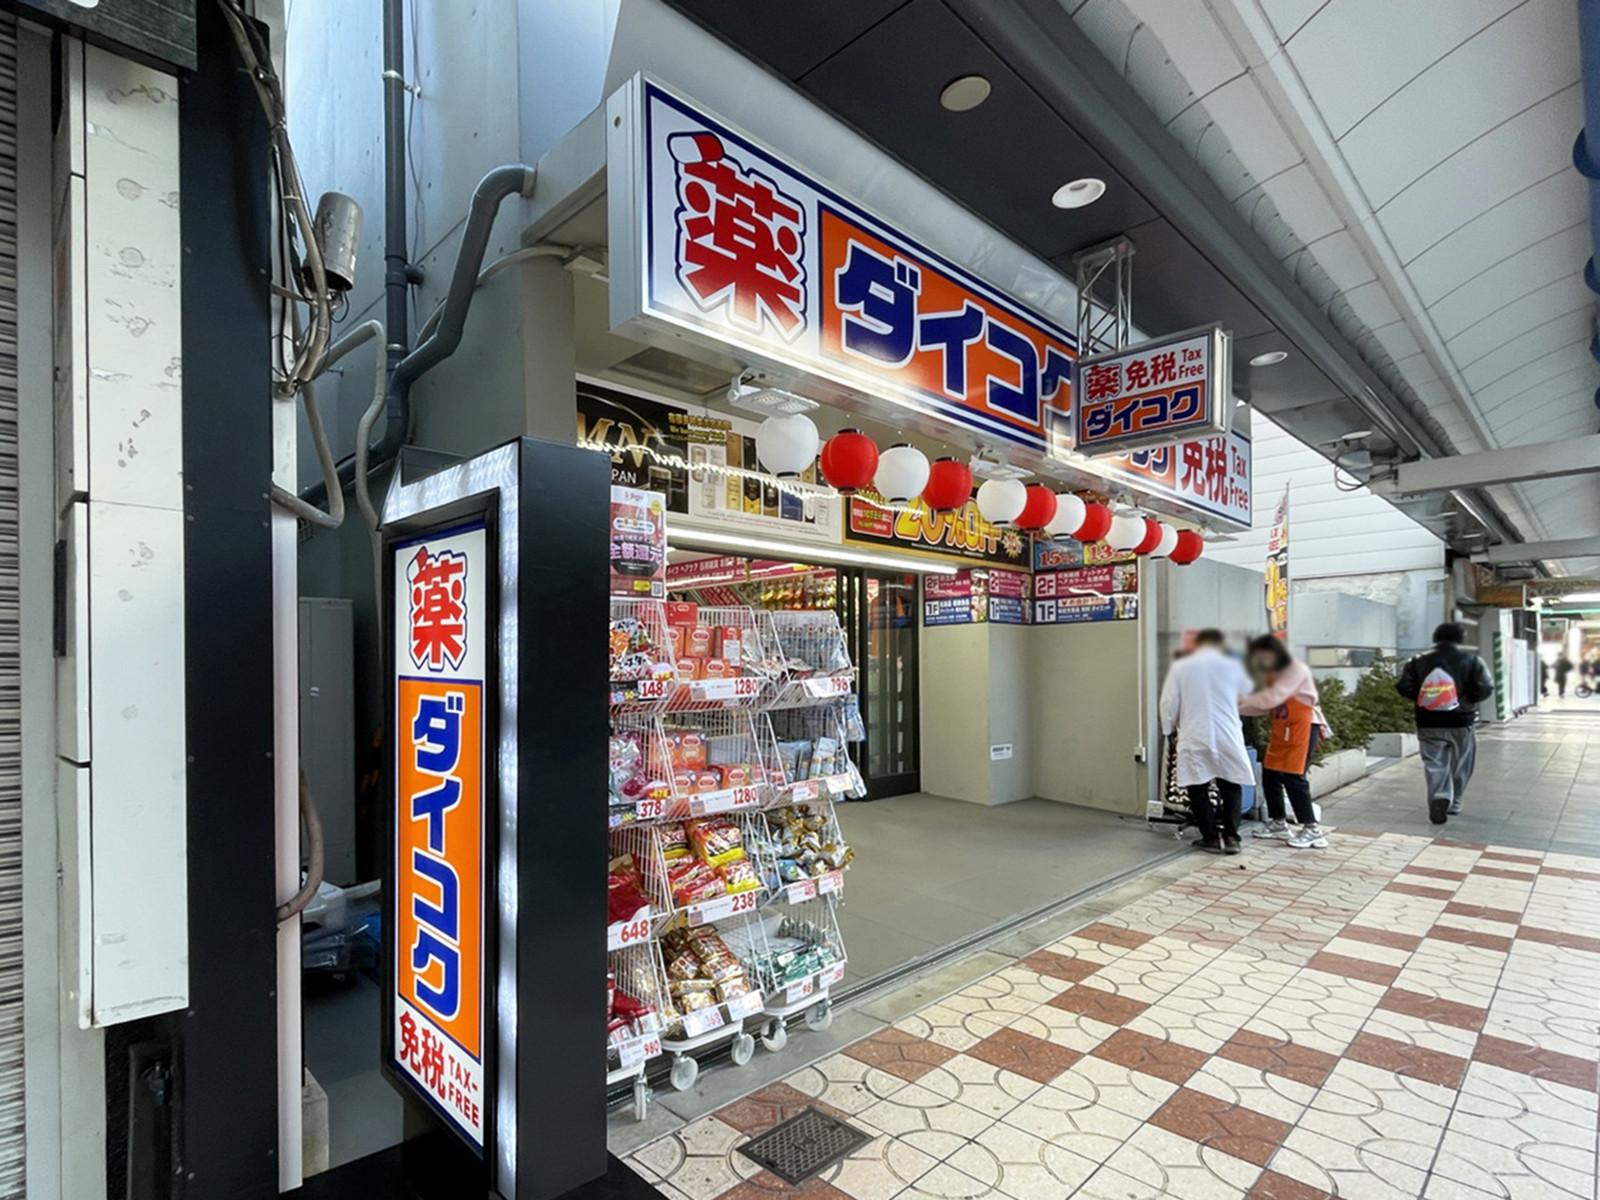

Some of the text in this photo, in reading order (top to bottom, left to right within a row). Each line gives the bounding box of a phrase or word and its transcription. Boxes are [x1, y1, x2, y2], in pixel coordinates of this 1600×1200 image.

[668, 132, 804, 341] 薬
[1182, 347, 1203, 362] Tax
[1086, 352, 1176, 401] 薬 免税
[1178, 363, 1204, 379] Free
[1086, 386, 1199, 437] ダイコク
[1181, 437, 1228, 506] 免税
[1231, 445, 1247, 480] Tax
[1229, 478, 1249, 510] Free
[1037, 576, 1054, 594] 2F
[407, 546, 467, 671] 薬
[1037, 603, 1054, 621] 1F
[641, 681, 664, 697] 148
[734, 679, 757, 695] 1280
[640, 802, 662, 818] 378
[733, 788, 757, 805] 1280
[411, 691, 464, 1022] ダイコク
[732, 891, 754, 912] 238
[621, 920, 649, 942] 648
[399, 1010, 446, 1100] 免税
[449, 1055, 478, 1092] TAX-
[449, 1085, 479, 1128] FREE
